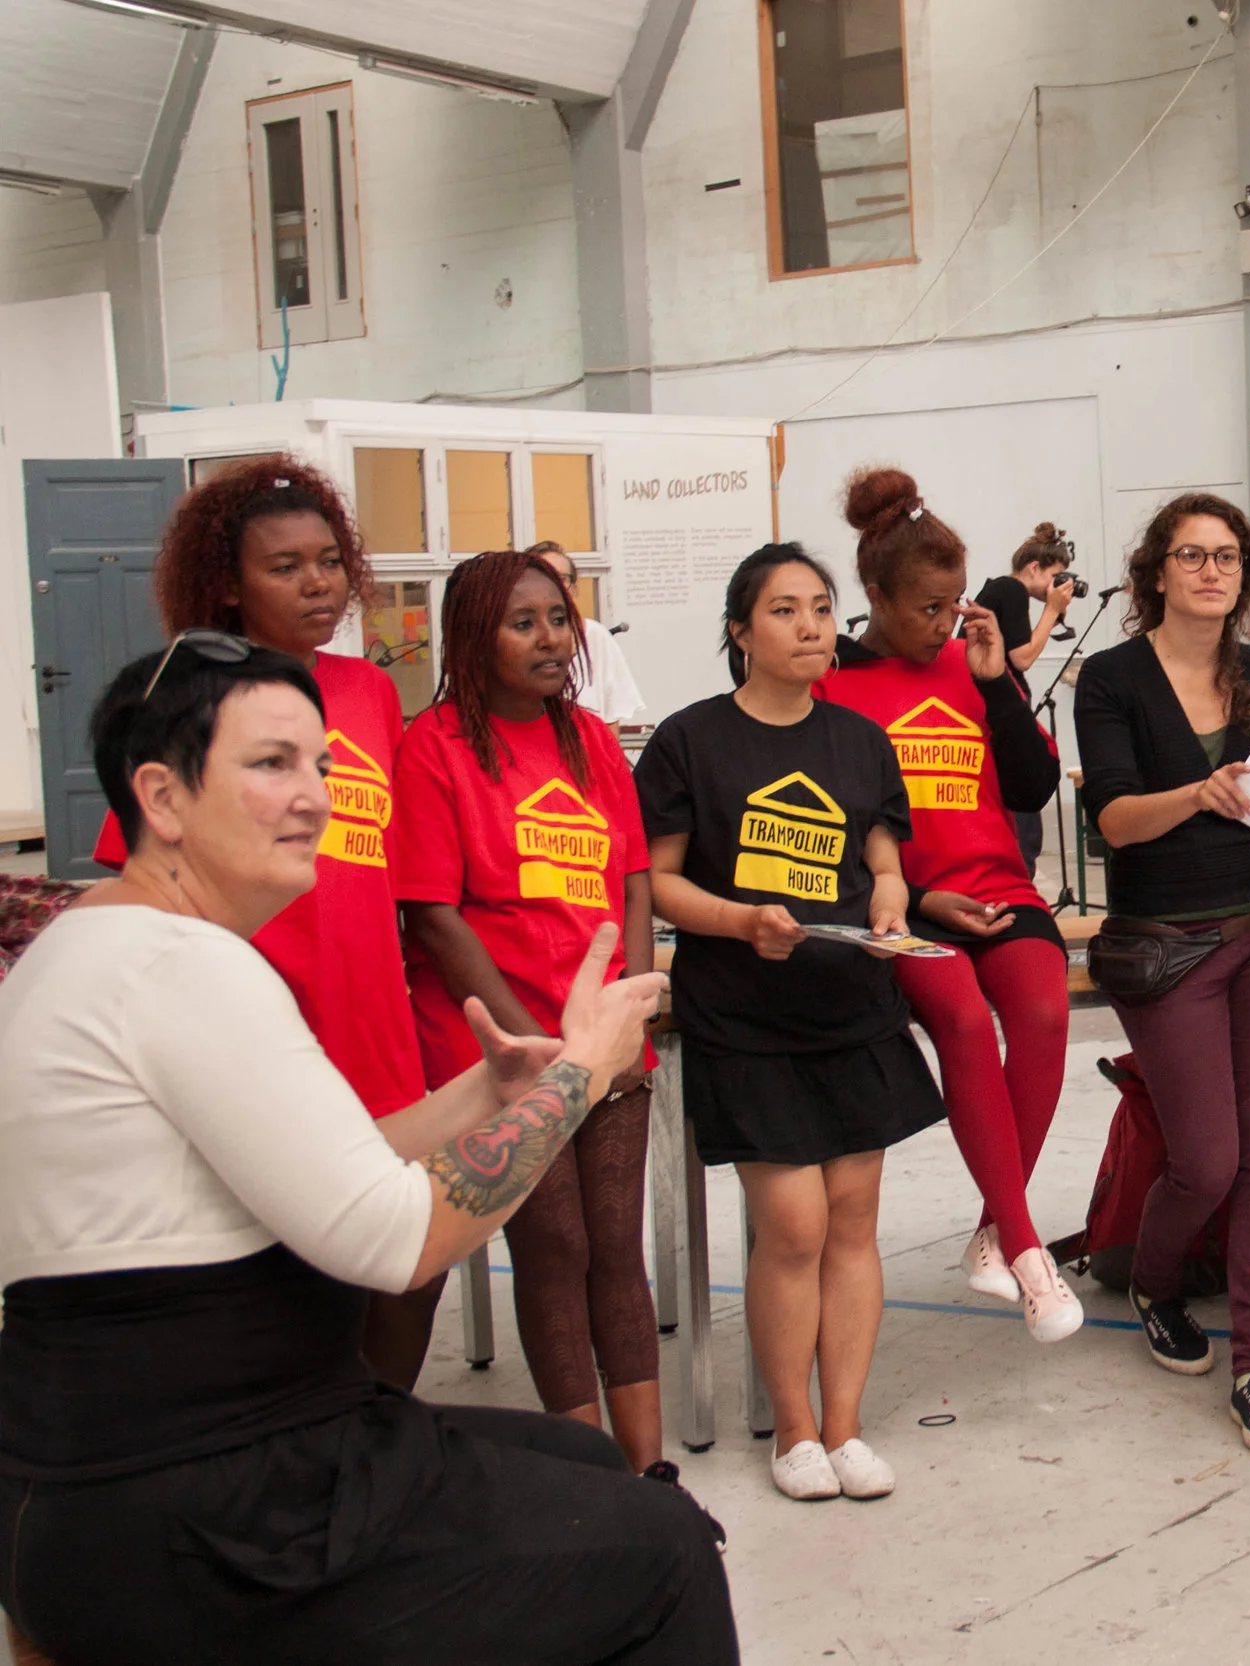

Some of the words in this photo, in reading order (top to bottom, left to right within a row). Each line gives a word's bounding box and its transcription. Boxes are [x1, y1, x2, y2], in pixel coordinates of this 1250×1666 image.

[623, 478, 661, 500] LAND
[667, 470, 748, 499] COLLECTORS
[344, 830, 385, 860] HOUS
[749, 818, 839, 858] TRAMPOLINE
[566, 875, 606, 902] HOUS
[787, 867, 832, 896] HOUSE
